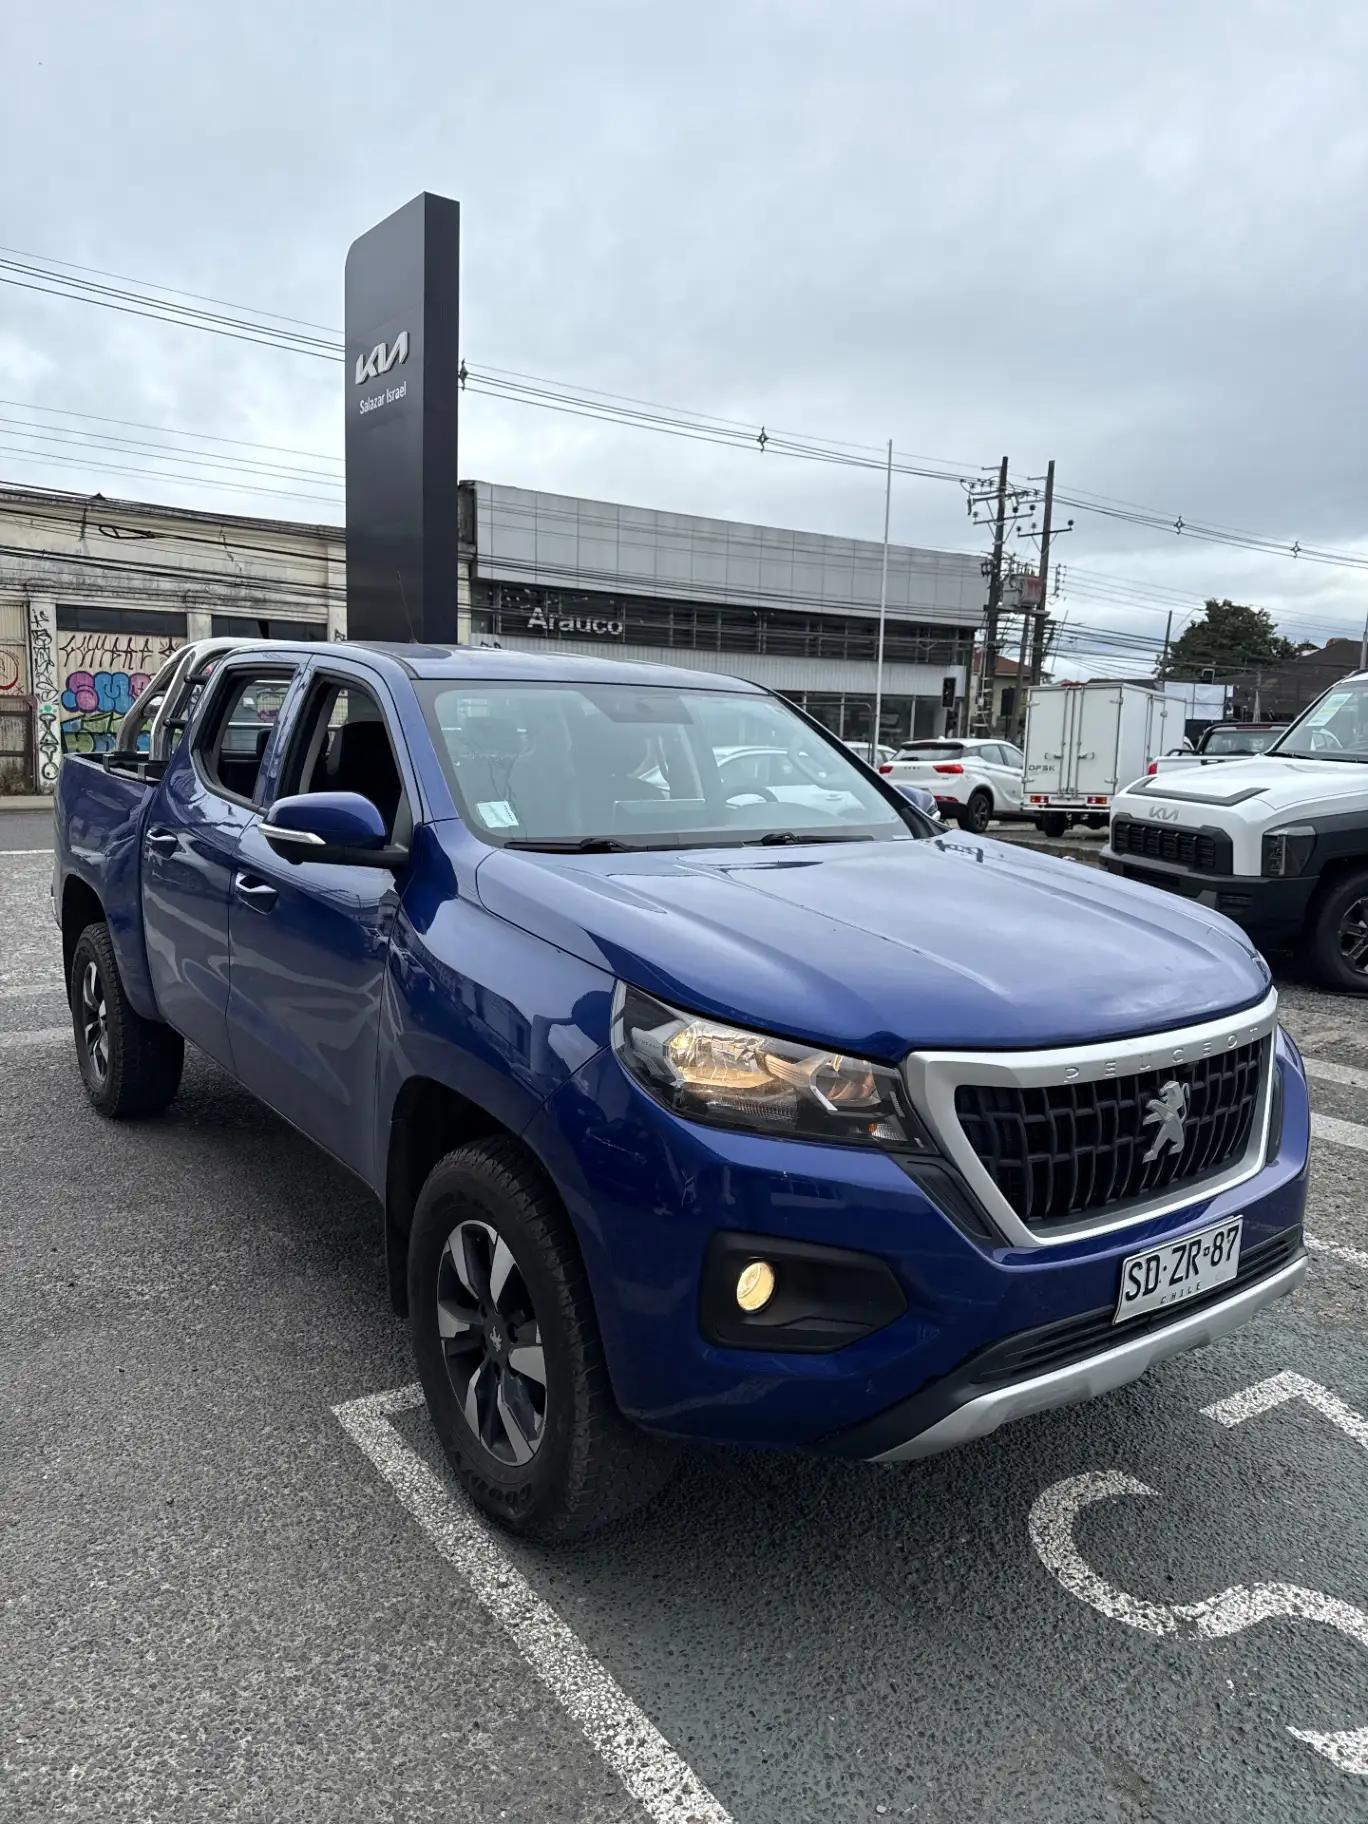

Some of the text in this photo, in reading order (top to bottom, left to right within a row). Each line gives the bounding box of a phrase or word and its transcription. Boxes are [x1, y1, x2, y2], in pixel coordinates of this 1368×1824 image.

[355, 330, 409, 385] KIA
[359, 380, 407, 415] Salazar Israel
[527, 606, 624, 636] Arauco
[1160, 1282, 1201, 1304] CHILE
